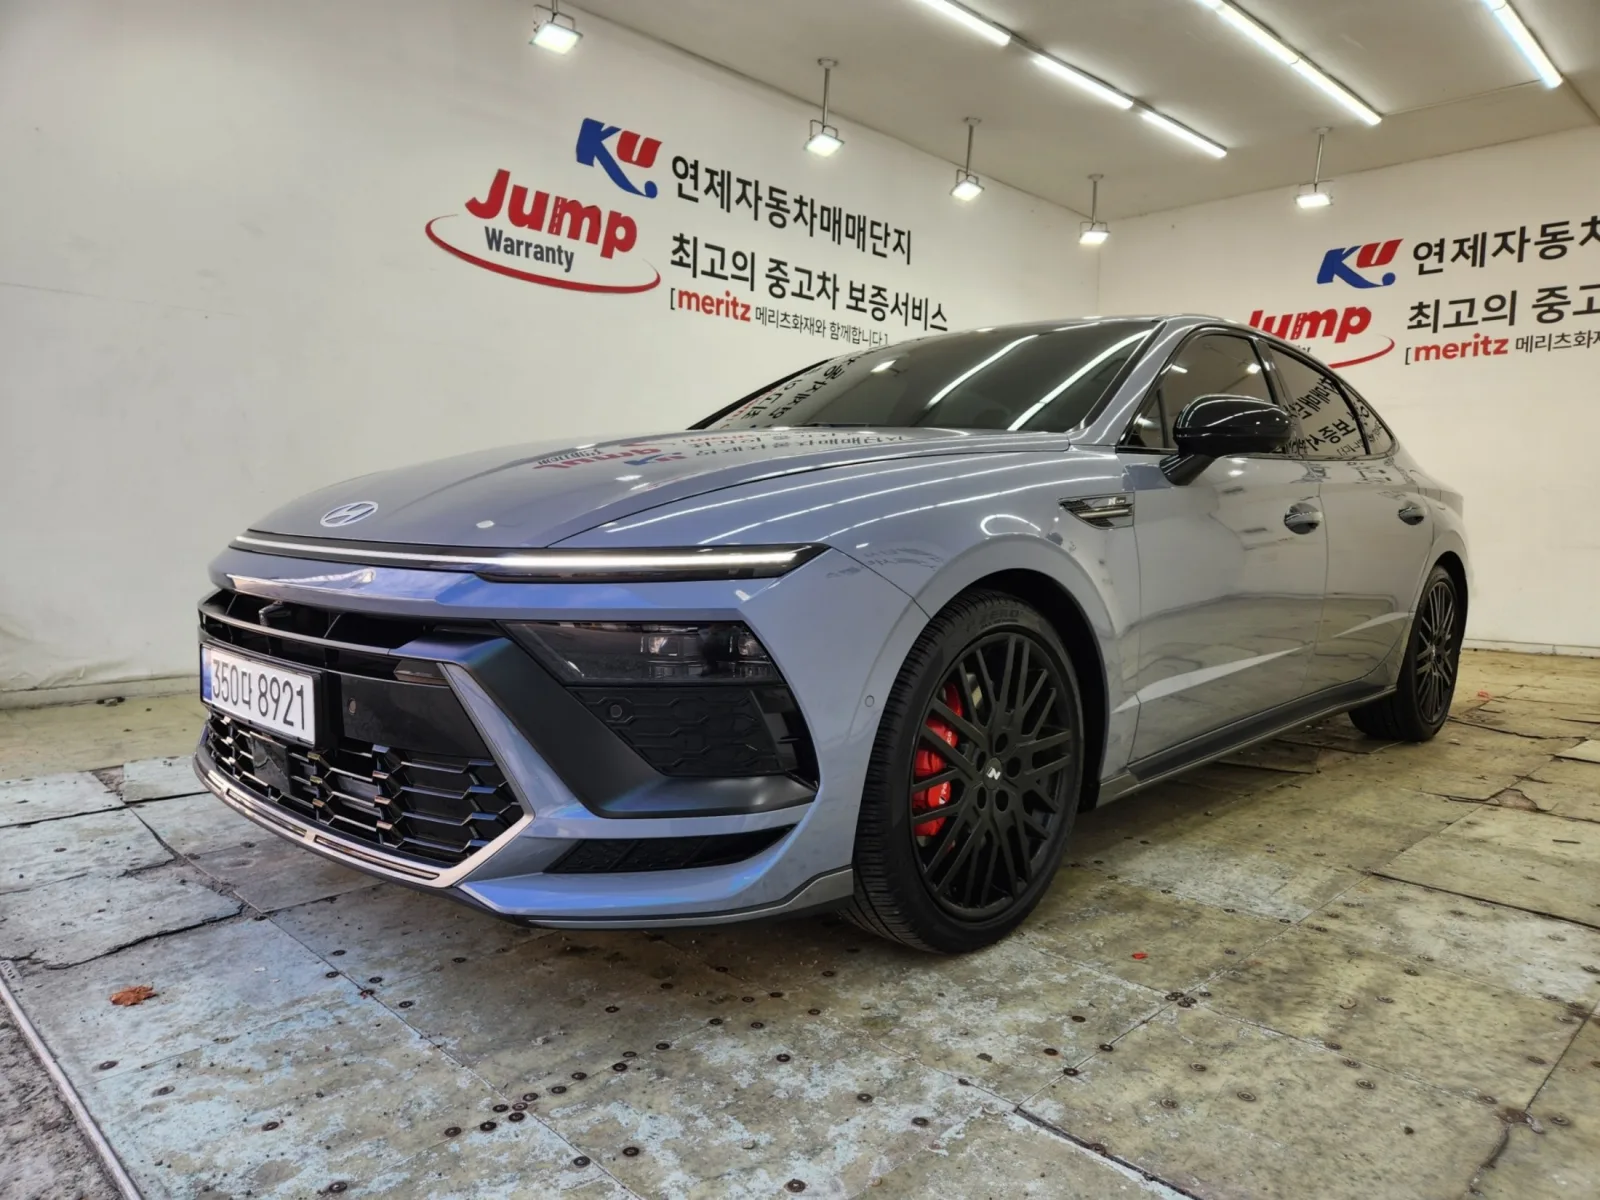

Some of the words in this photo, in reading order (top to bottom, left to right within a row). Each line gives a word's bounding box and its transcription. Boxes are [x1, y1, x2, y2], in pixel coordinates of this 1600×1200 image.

[465, 168, 637, 259] Jump
[672, 156, 911, 265] 연제자동차매매단지
[484, 226, 574, 273] Warranty
[670, 233, 755, 291] 최고의
[765, 258, 839, 310] 중고차
[846, 280, 948, 331] 보증서비스
[755, 306, 826, 338] 메리츠화재와
[1407, 290, 1517, 335] 최고의
